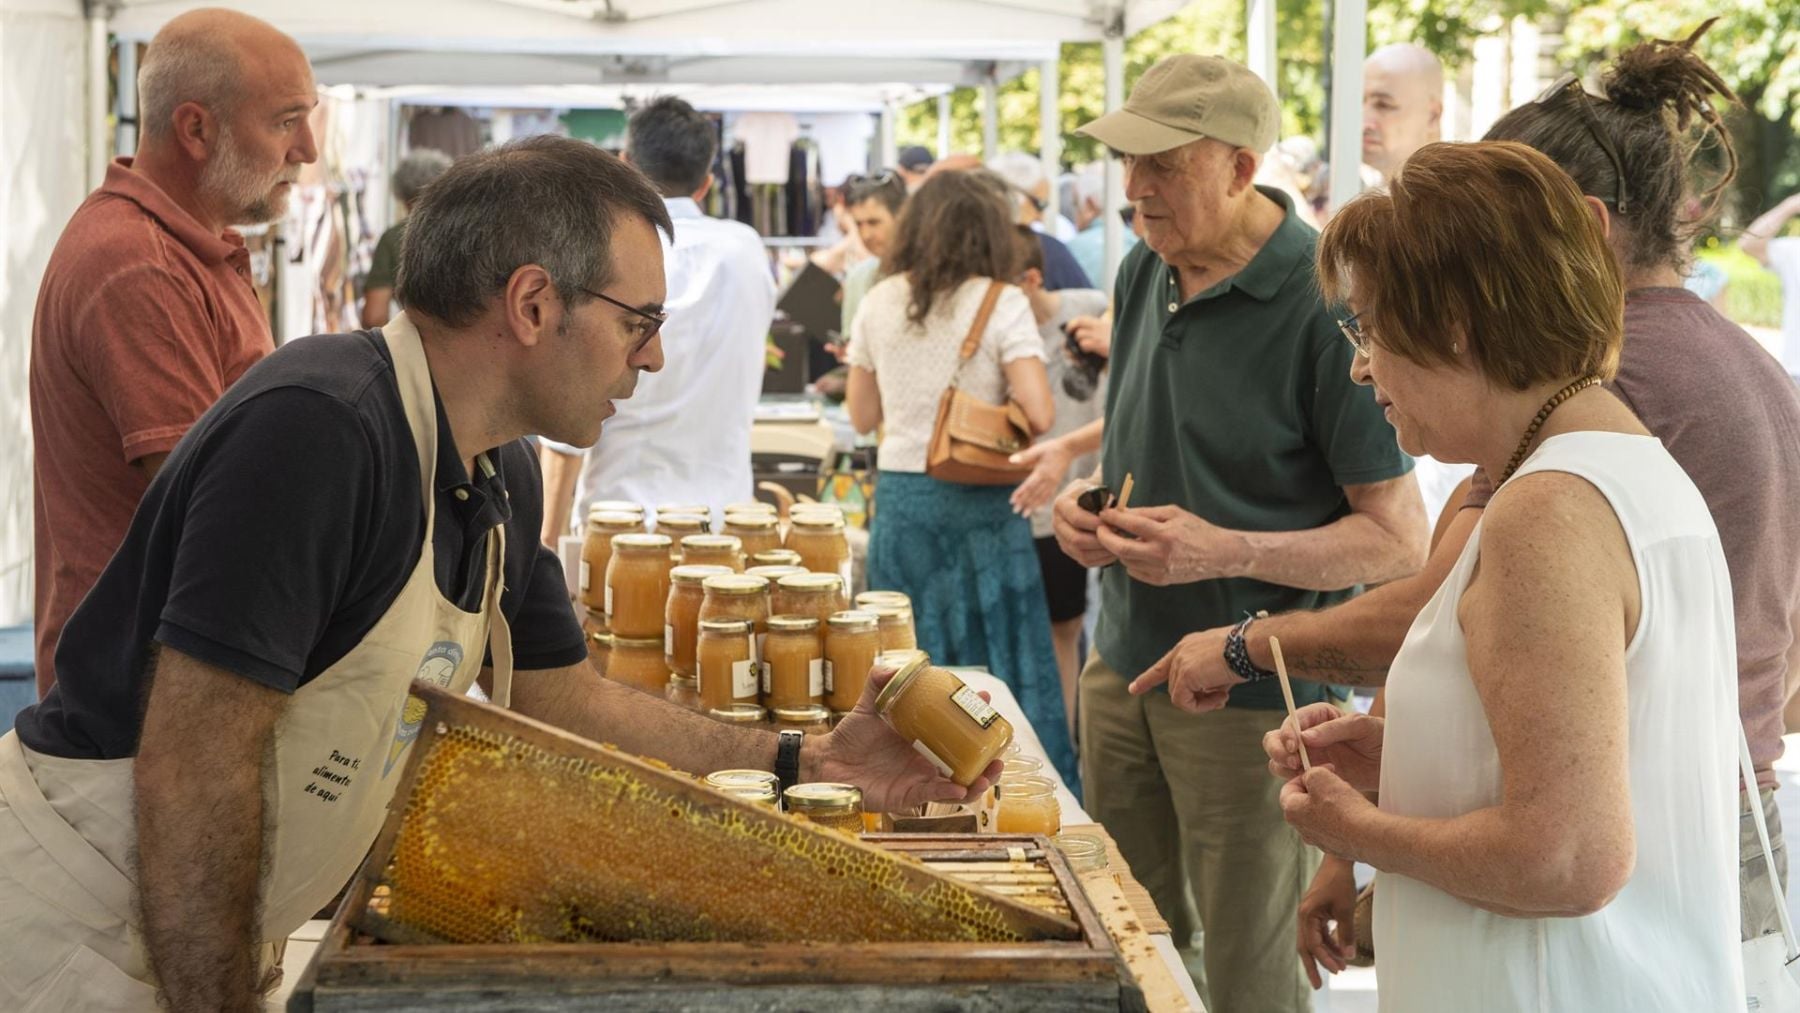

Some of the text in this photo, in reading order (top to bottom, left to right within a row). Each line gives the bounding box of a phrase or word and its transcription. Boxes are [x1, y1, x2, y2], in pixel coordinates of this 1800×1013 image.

[329, 749, 351, 767] Para
[312, 765, 352, 788] alimento
[304, 782, 342, 802] de aquí
